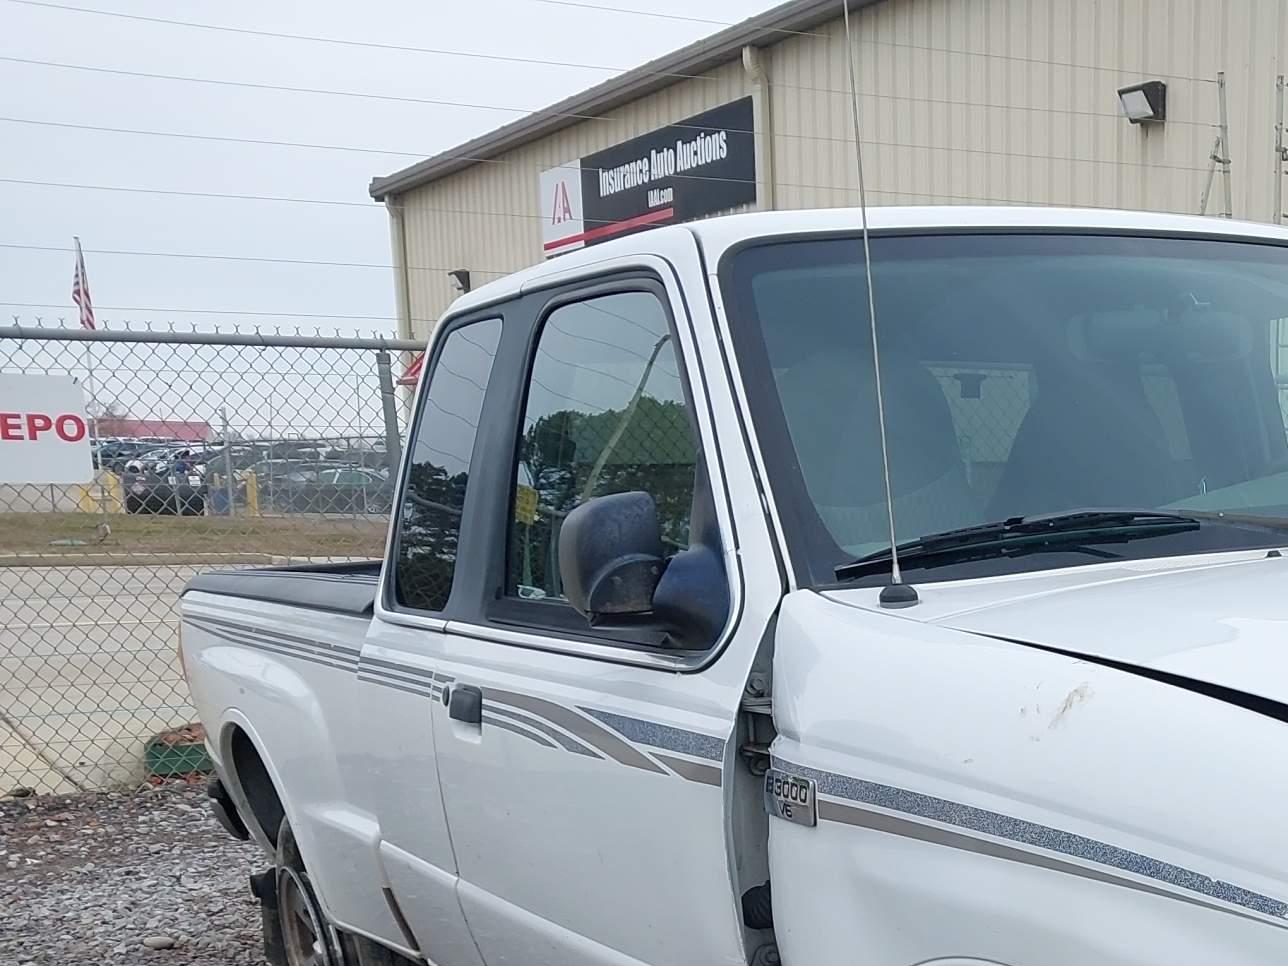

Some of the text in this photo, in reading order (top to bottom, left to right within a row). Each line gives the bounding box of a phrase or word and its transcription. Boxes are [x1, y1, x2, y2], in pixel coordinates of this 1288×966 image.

[599, 130, 727, 196] Insurance Auto Auctions
[779, 802, 793, 818] V6
